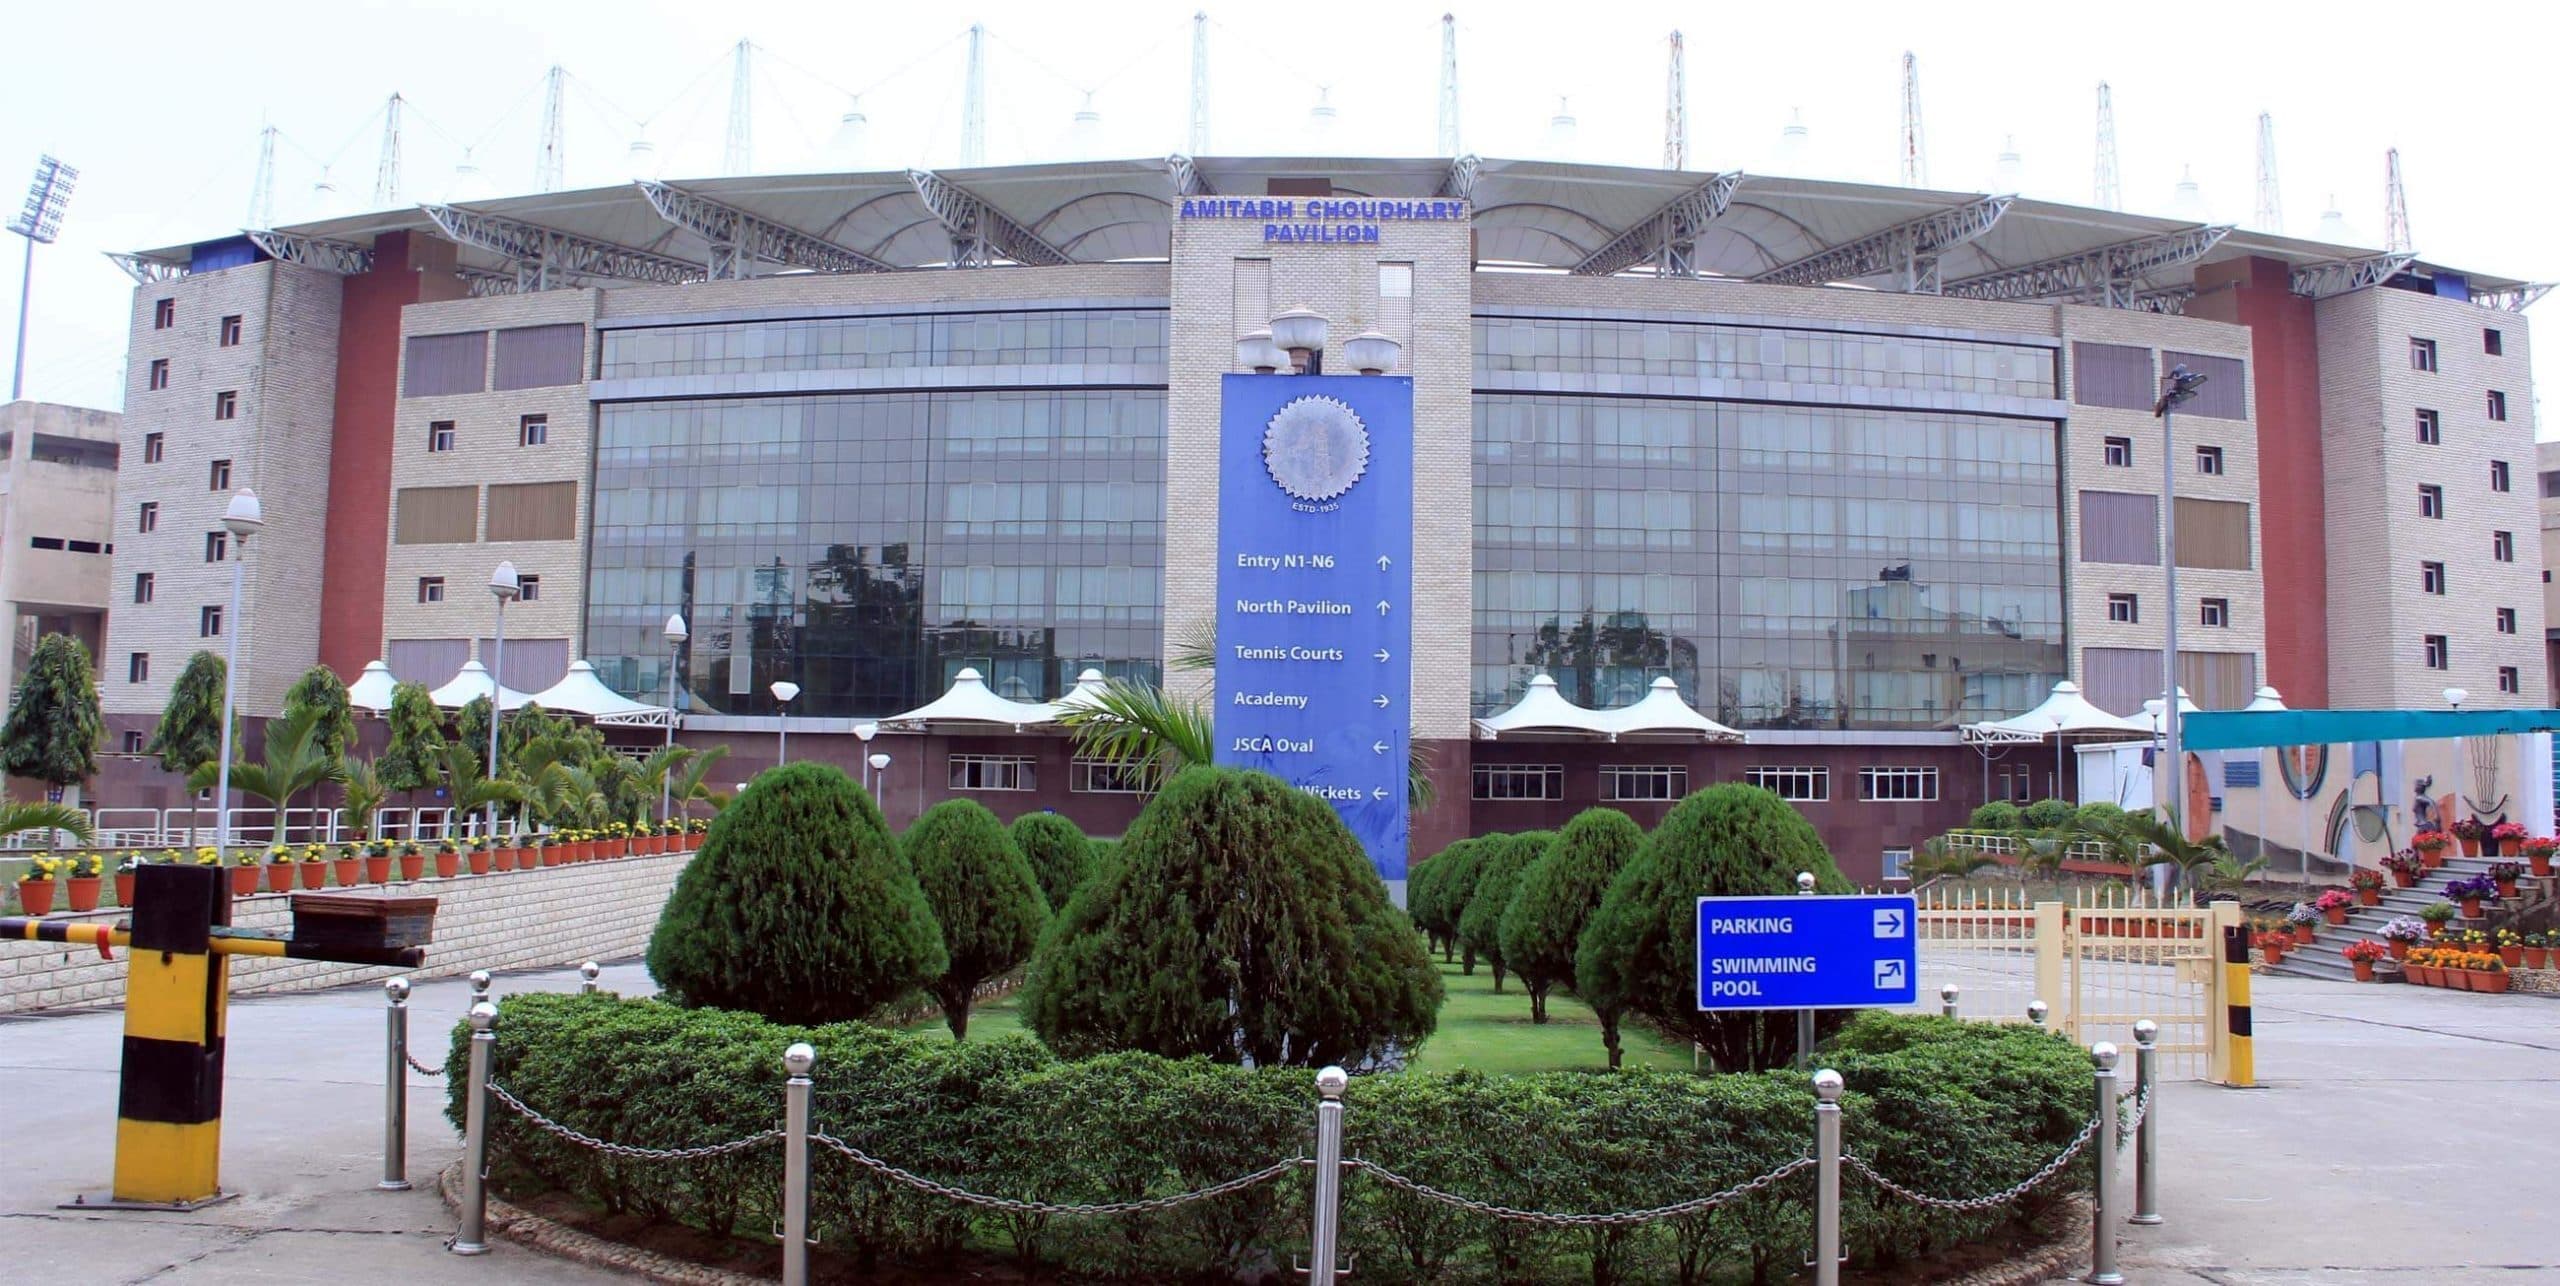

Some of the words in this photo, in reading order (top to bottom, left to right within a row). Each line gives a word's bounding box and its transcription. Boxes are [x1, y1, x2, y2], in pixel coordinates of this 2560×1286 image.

[1180, 200, 1293, 219] AMITABH
[1307, 200, 1464, 219] CHOUDHARY
[1264, 224, 1379, 243] PAVILION
[1237, 554, 1280, 571] Entry
[1284, 554, 1335, 569] N1-N6
[1237, 600, 1283, 614] North
[1287, 600, 1351, 615] Pavilion
[1235, 645, 1287, 660] Tennis
[1290, 646, 1343, 661] Courts
[1234, 691, 1308, 709] Academy
[1232, 737, 1273, 752] JSCA
[1276, 737, 1314, 752] Oval
[1711, 917, 1793, 934] PARKING
[1711, 956, 1817, 974] SWIMMING
[1711, 980, 1763, 996] POOL
